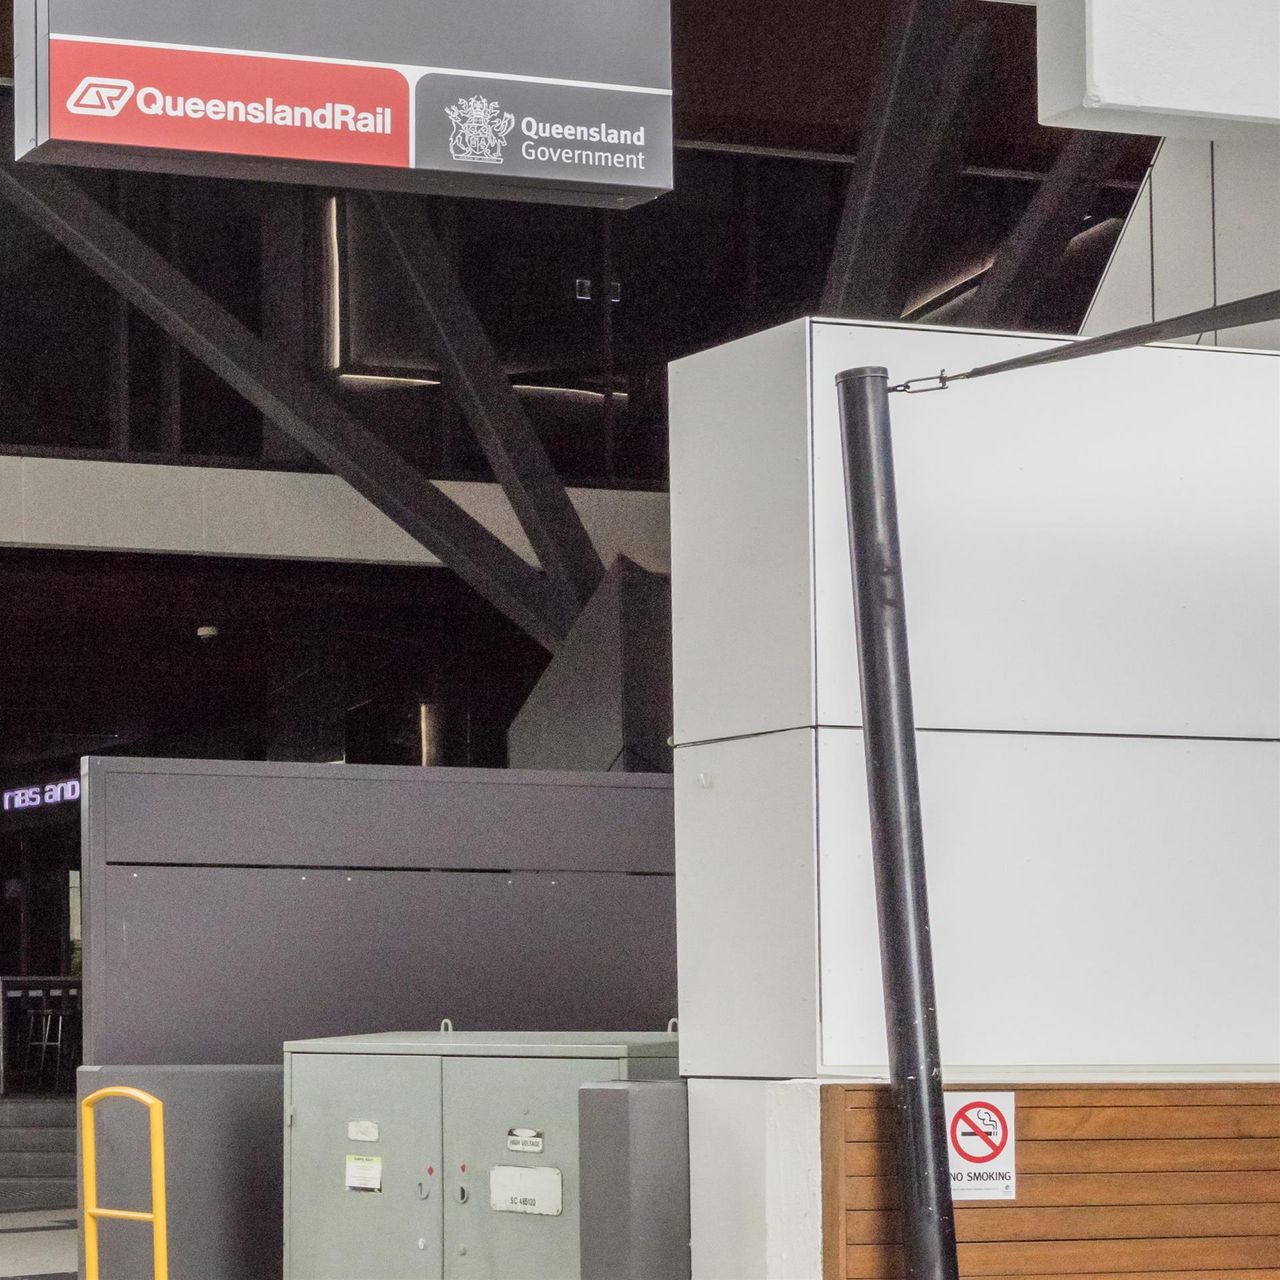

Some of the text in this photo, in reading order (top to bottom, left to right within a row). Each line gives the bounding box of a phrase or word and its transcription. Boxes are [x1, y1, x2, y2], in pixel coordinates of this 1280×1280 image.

[136, 86, 392, 135] QueenslandRail
[521, 116, 646, 146] Queensland
[521, 141, 646, 170] Government
[950, 1172, 1012, 1181] NO SMOKING
